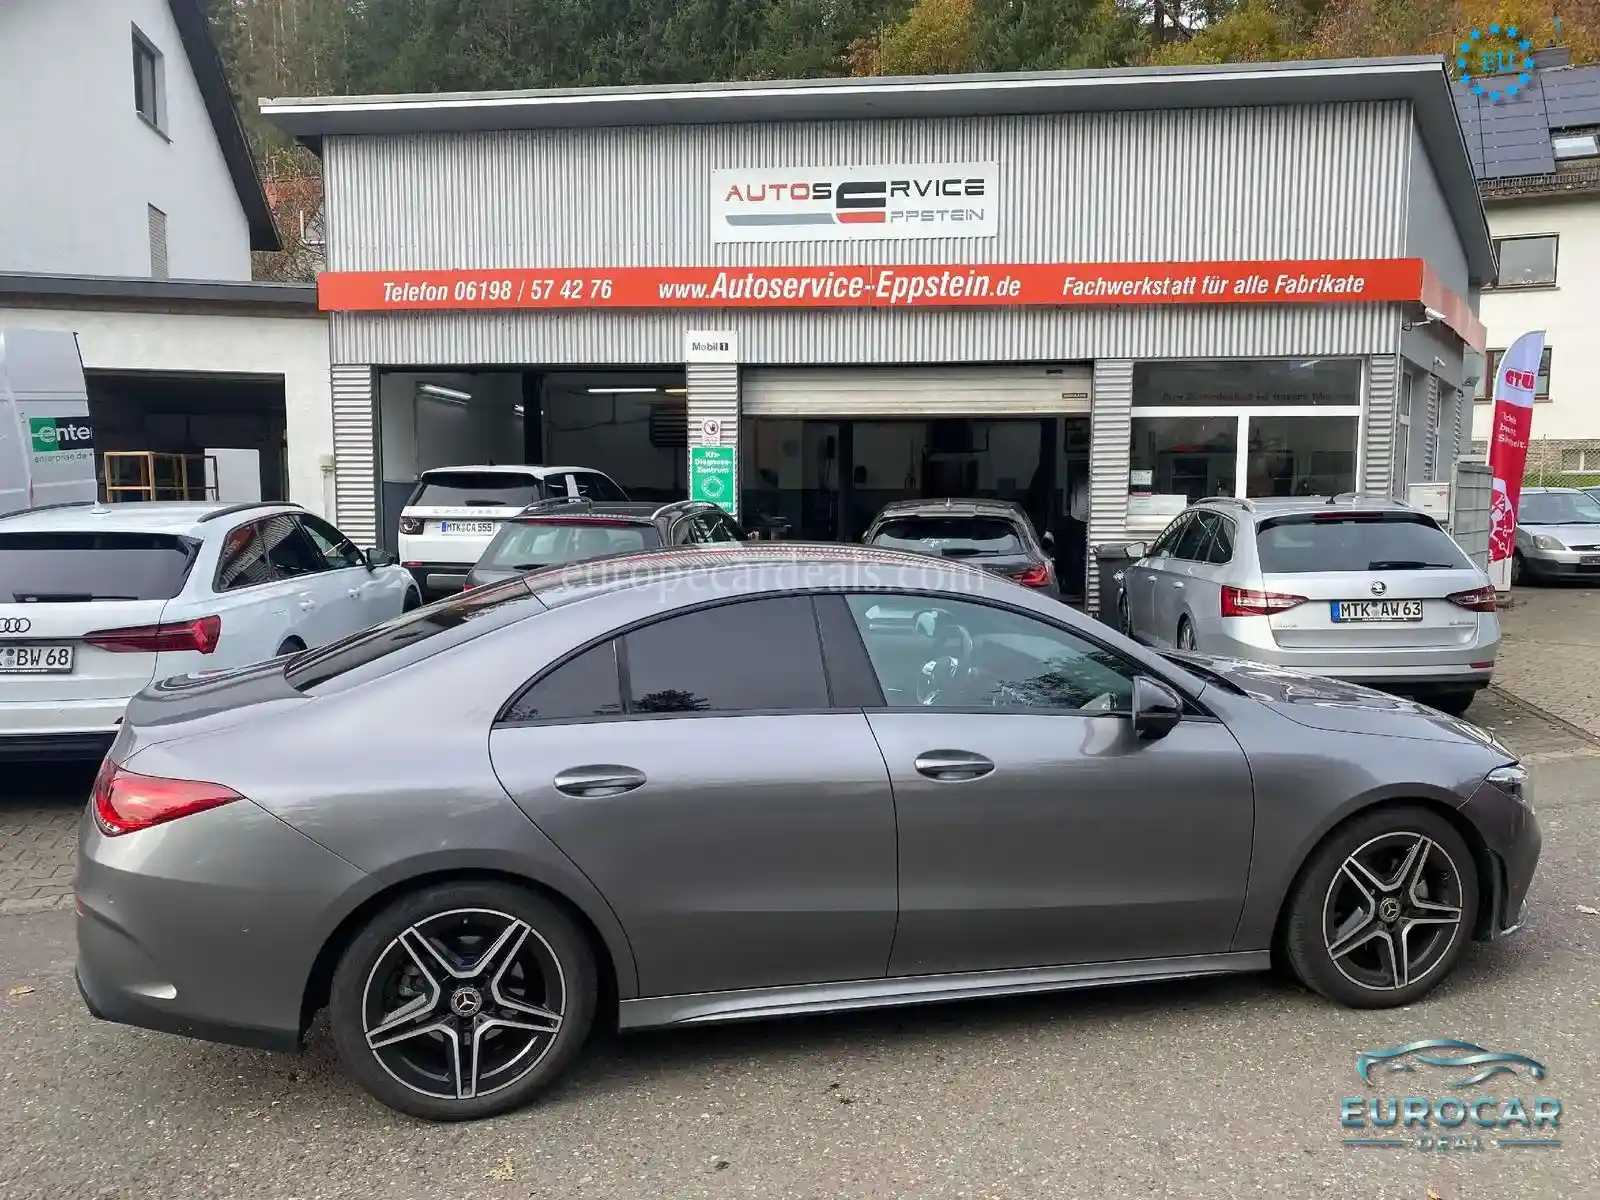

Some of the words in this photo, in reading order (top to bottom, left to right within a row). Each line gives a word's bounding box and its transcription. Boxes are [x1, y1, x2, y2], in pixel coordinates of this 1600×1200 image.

[383, 281, 449, 302] Telefon
[454, 279, 512, 301] 06198
[516, 279, 526, 304] /
[530, 279, 554, 301] 57
[559, 279, 583, 300] 42
[590, 279, 613, 300] 76
[658, 270, 1022, 303] www.Autoservice-Eppstein.de
[1062, 275, 1198, 297] Fachwerkstatt
[1200, 274, 1229, 296] für
[1233, 274, 1269, 295] alle
[1274, 273, 1366, 295] Fabrikate
[692, 342, 718, 352] Mobil
[1505, 369, 1534, 391] GTÜ
[446, 522, 461, 532] MTK
[466, 522, 476, 532] CA
[478, 522, 492, 532] 555
[1341, 602, 1371, 617] MTK
[1380, 602, 1400, 616] AW
[1402, 601, 1421, 616] 63
[16, 648, 42, 666] BW
[45, 648, 69, 666] 68
